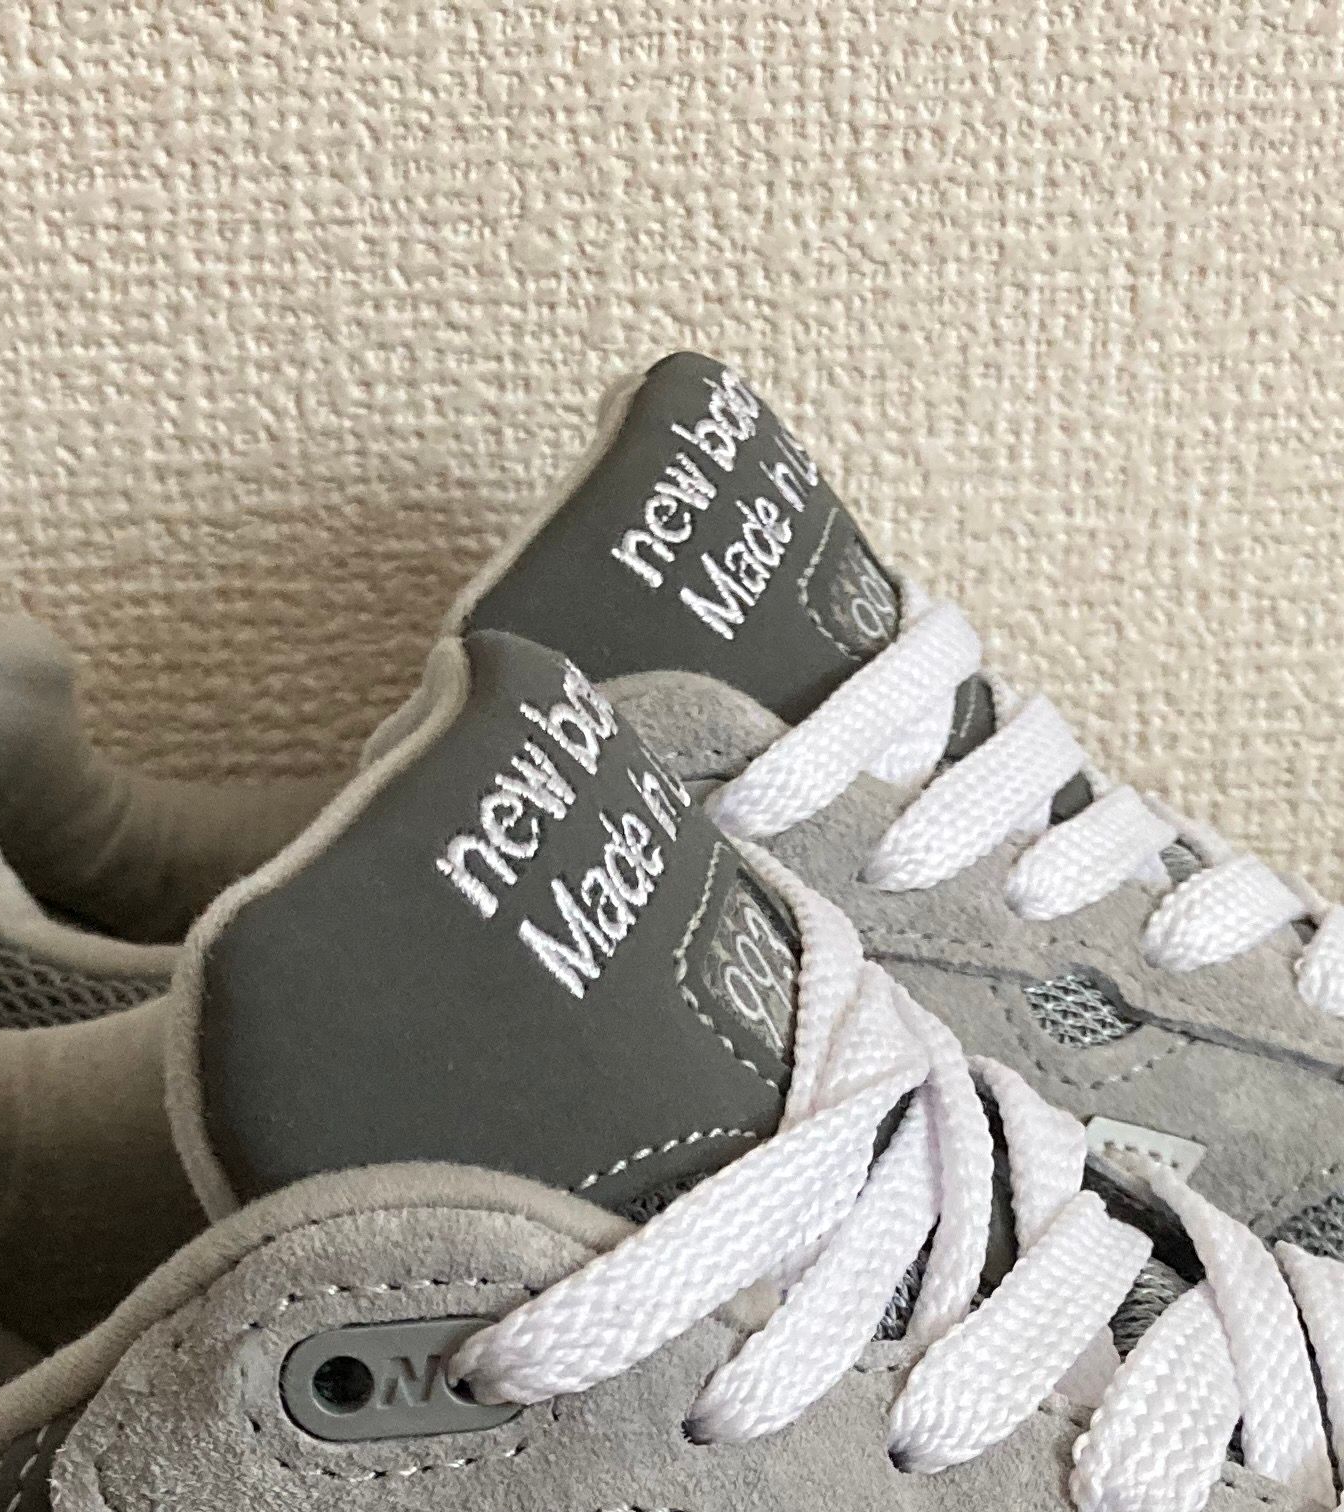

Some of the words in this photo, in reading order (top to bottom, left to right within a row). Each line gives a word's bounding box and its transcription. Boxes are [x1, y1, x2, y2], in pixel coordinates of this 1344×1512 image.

[611, 452, 718, 588] new
[679, 495, 793, 641] Made
[434, 737, 577, 920] new
[517, 810, 665, 1001] Made
[376, 1353, 445, 1410] N
